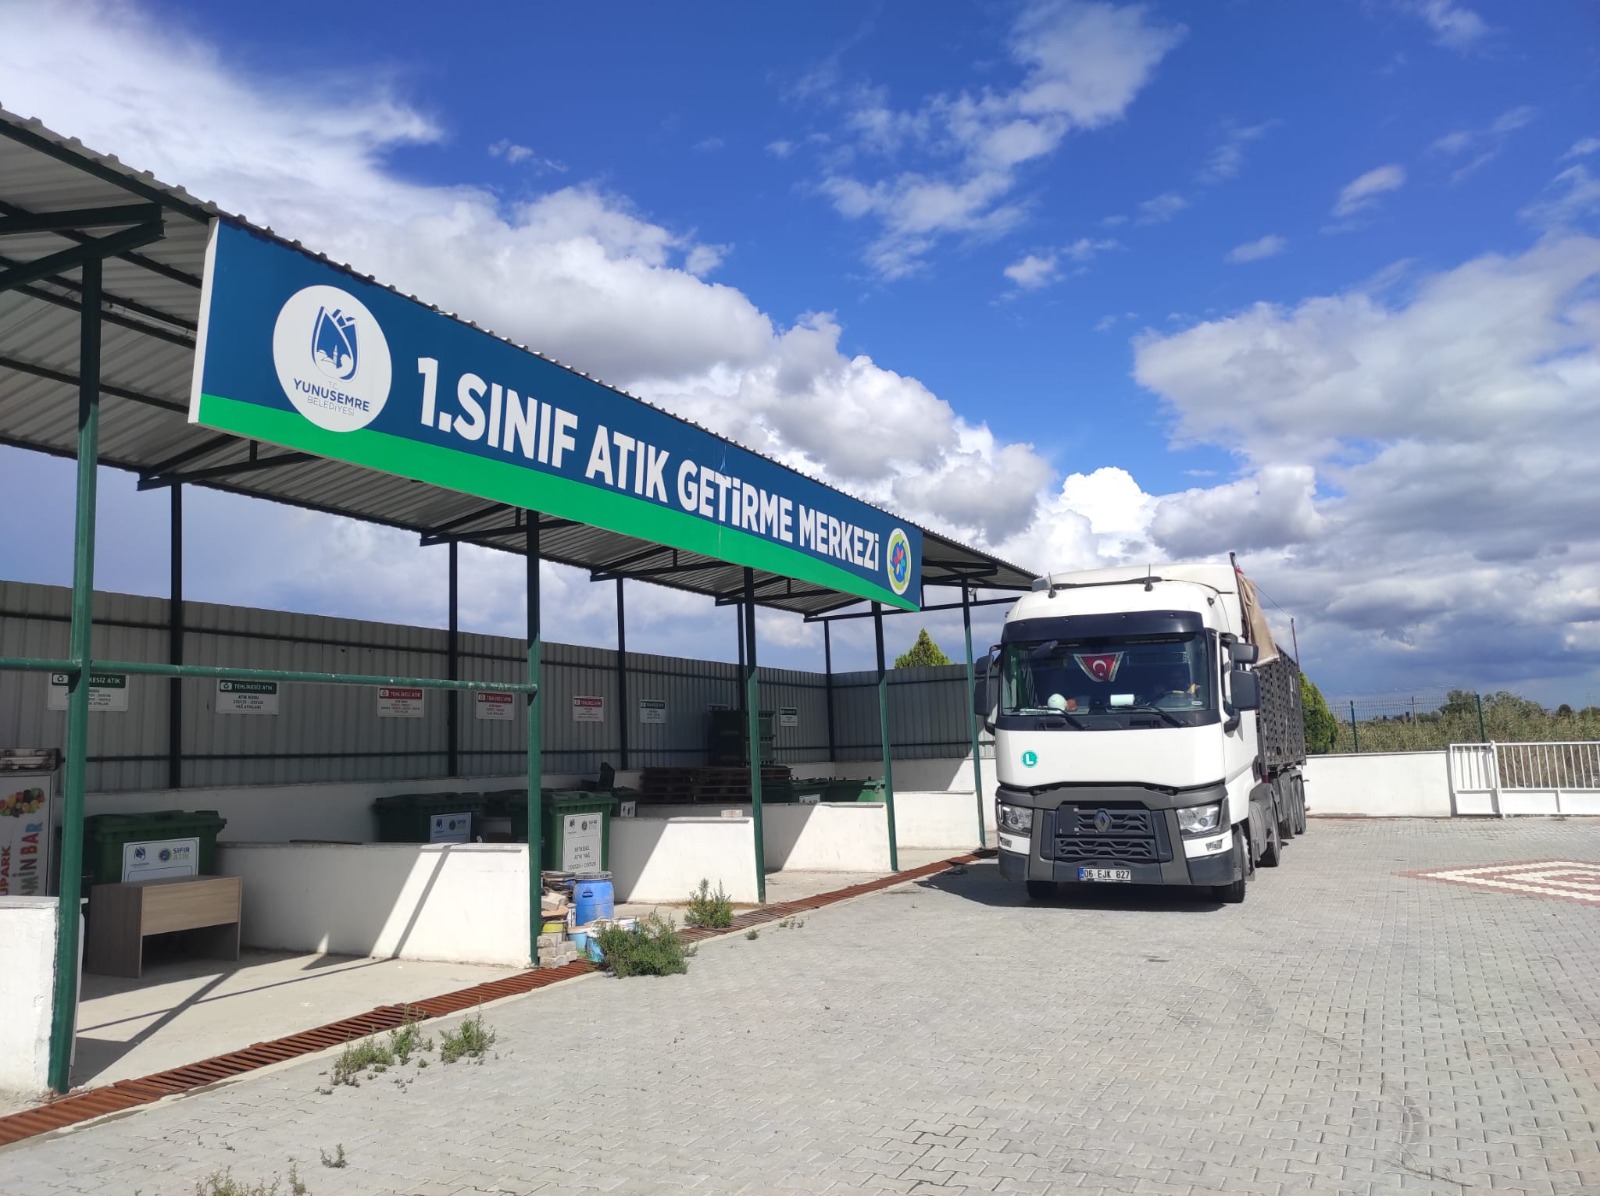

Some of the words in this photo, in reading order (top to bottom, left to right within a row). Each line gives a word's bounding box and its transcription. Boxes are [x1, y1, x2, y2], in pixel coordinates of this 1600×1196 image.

[294, 378, 370, 412] YUNUSEMRE
[307, 395, 355, 417] BELEDİYESİ
[418, 357, 578, 469] 1.SINIF
[585, 424, 669, 503] ATIK
[677, 459, 793, 543] GETİRME
[799, 504, 879, 571] MERKEZİ
[1026, 754, 1034, 764] L
[1084, 869, 1093, 878] 06
[1115, 870, 1130, 880] 827
